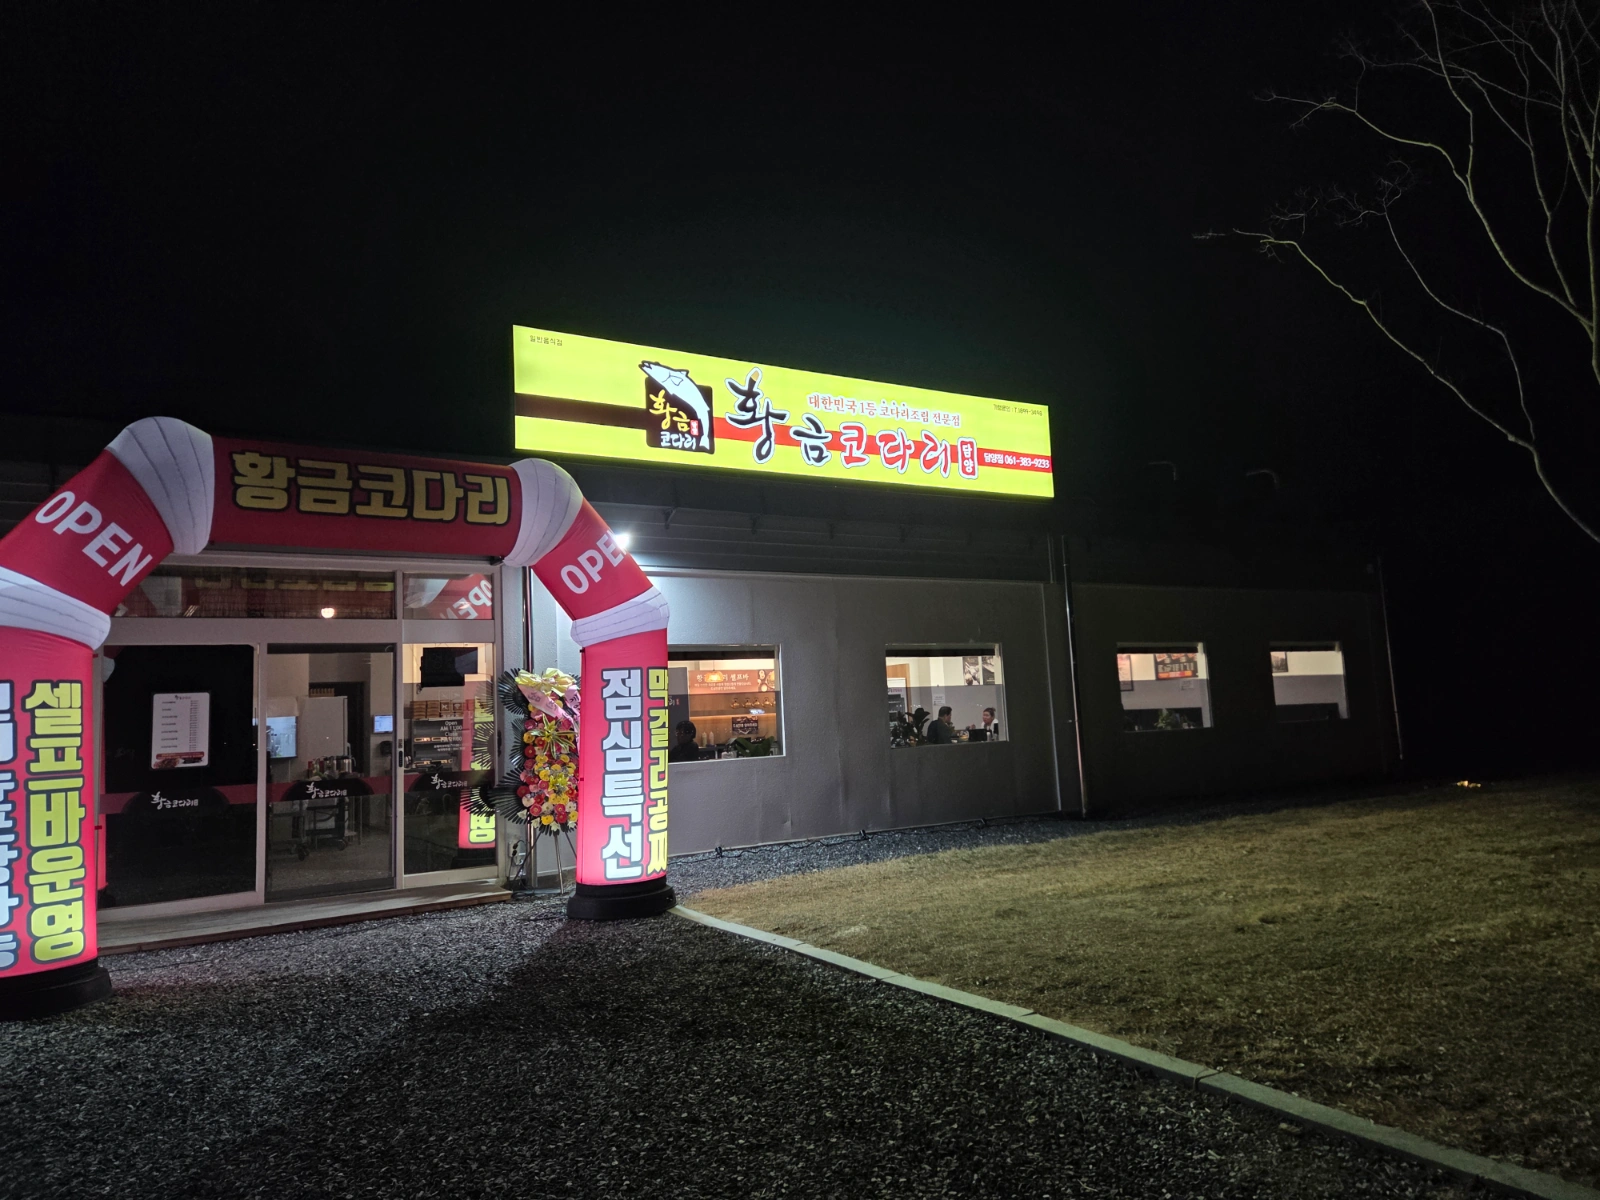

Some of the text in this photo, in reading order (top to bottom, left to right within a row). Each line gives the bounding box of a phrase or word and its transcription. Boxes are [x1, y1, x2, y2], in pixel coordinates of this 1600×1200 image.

[530, 335, 563, 346] 일반음식점
[649, 389, 691, 432] 황금
[808, 394, 961, 427] 대한민국 1등 코다리조림 전문점
[660, 431, 697, 450] 코다리
[962, 444, 974, 473] 담양
[984, 452, 1051, 469] 담양점 061-383-9233
[230, 451, 511, 526] 황금코다리
[35, 490, 153, 587] OPEN
[602, 668, 644, 880] 점심특선
[150, 790, 194, 811] 황금코다리
[25, 681, 86, 962] 셀프바운영
